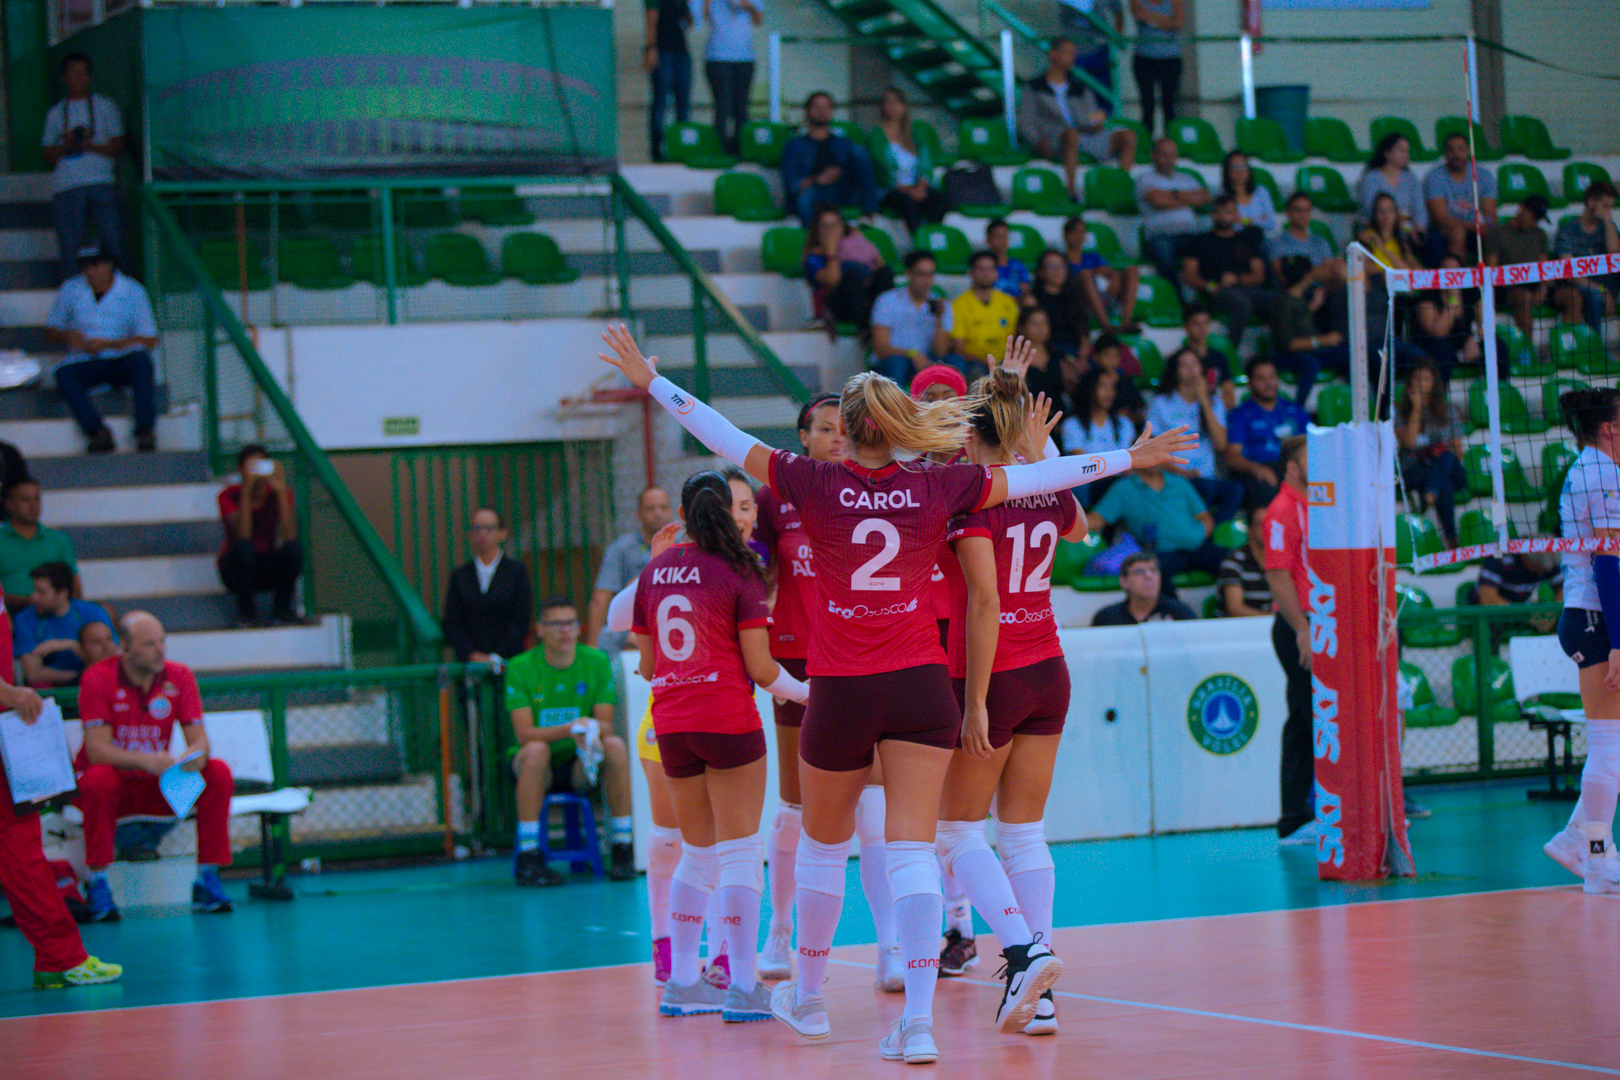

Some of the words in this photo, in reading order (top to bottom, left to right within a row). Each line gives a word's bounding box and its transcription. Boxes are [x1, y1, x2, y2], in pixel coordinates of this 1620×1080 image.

[1412, 270, 1435, 289] SKY
[1444, 270, 1466, 287] SKY
[1508, 265, 1531, 284] SKY
[1541, 260, 1566, 280] SKY
[1576, 257, 1600, 276] SKY
[839, 488, 920, 510] CAROL
[652, 566, 701, 585] KIKA
[851, 518, 901, 591] 2
[1006, 520, 1058, 594] 12
[656, 594, 696, 662] 6
[1308, 566, 1338, 660] SKY
[1311, 673, 1341, 764] SKY
[1314, 778, 1344, 868] SKY
